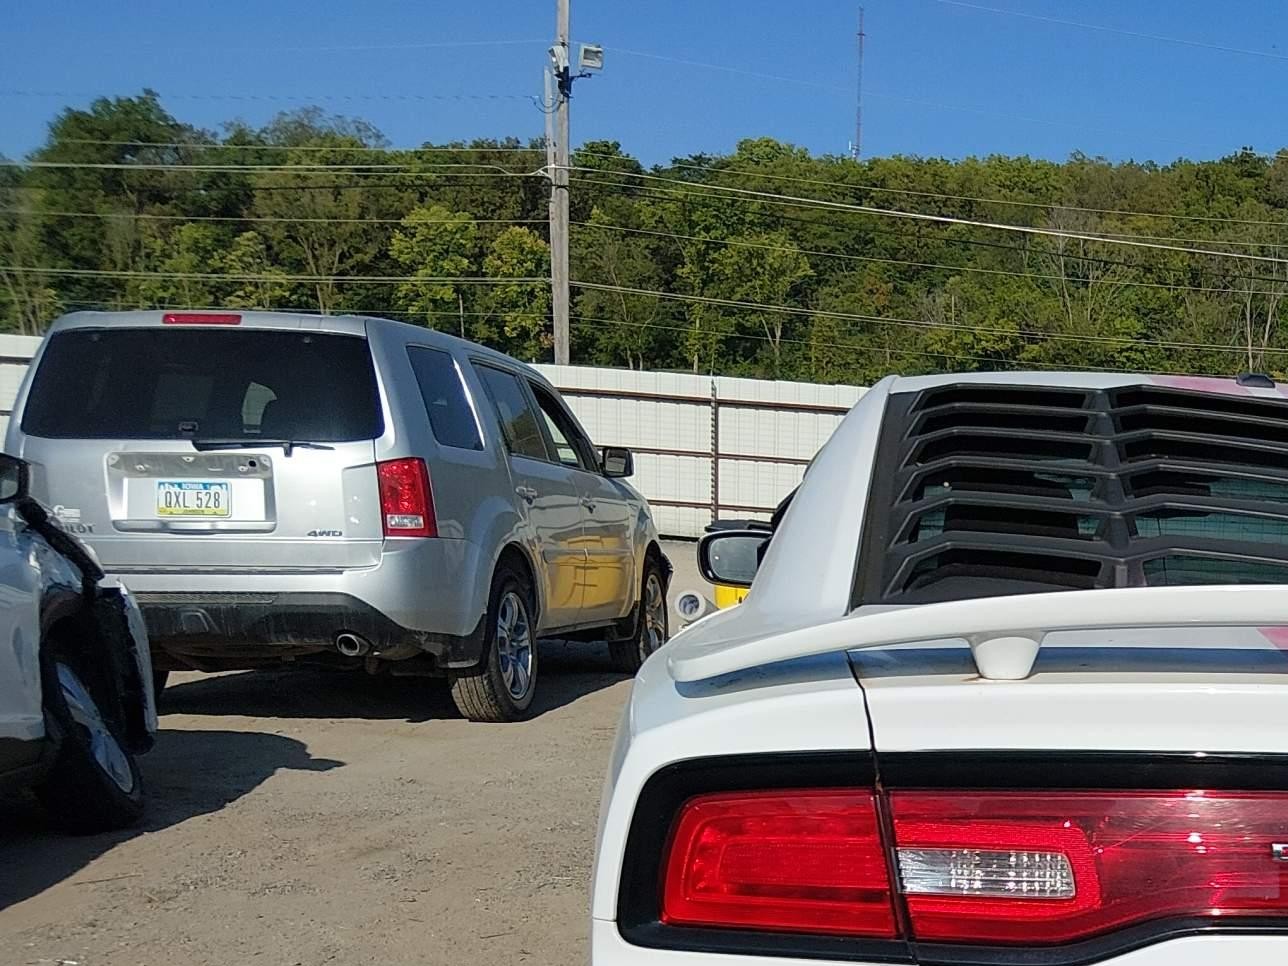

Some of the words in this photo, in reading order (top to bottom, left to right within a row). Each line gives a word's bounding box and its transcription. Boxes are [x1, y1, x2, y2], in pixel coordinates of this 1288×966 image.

[164, 490, 190, 509] QXL
[196, 491, 221, 509] 528
[306, 529, 343, 538] 4WD
